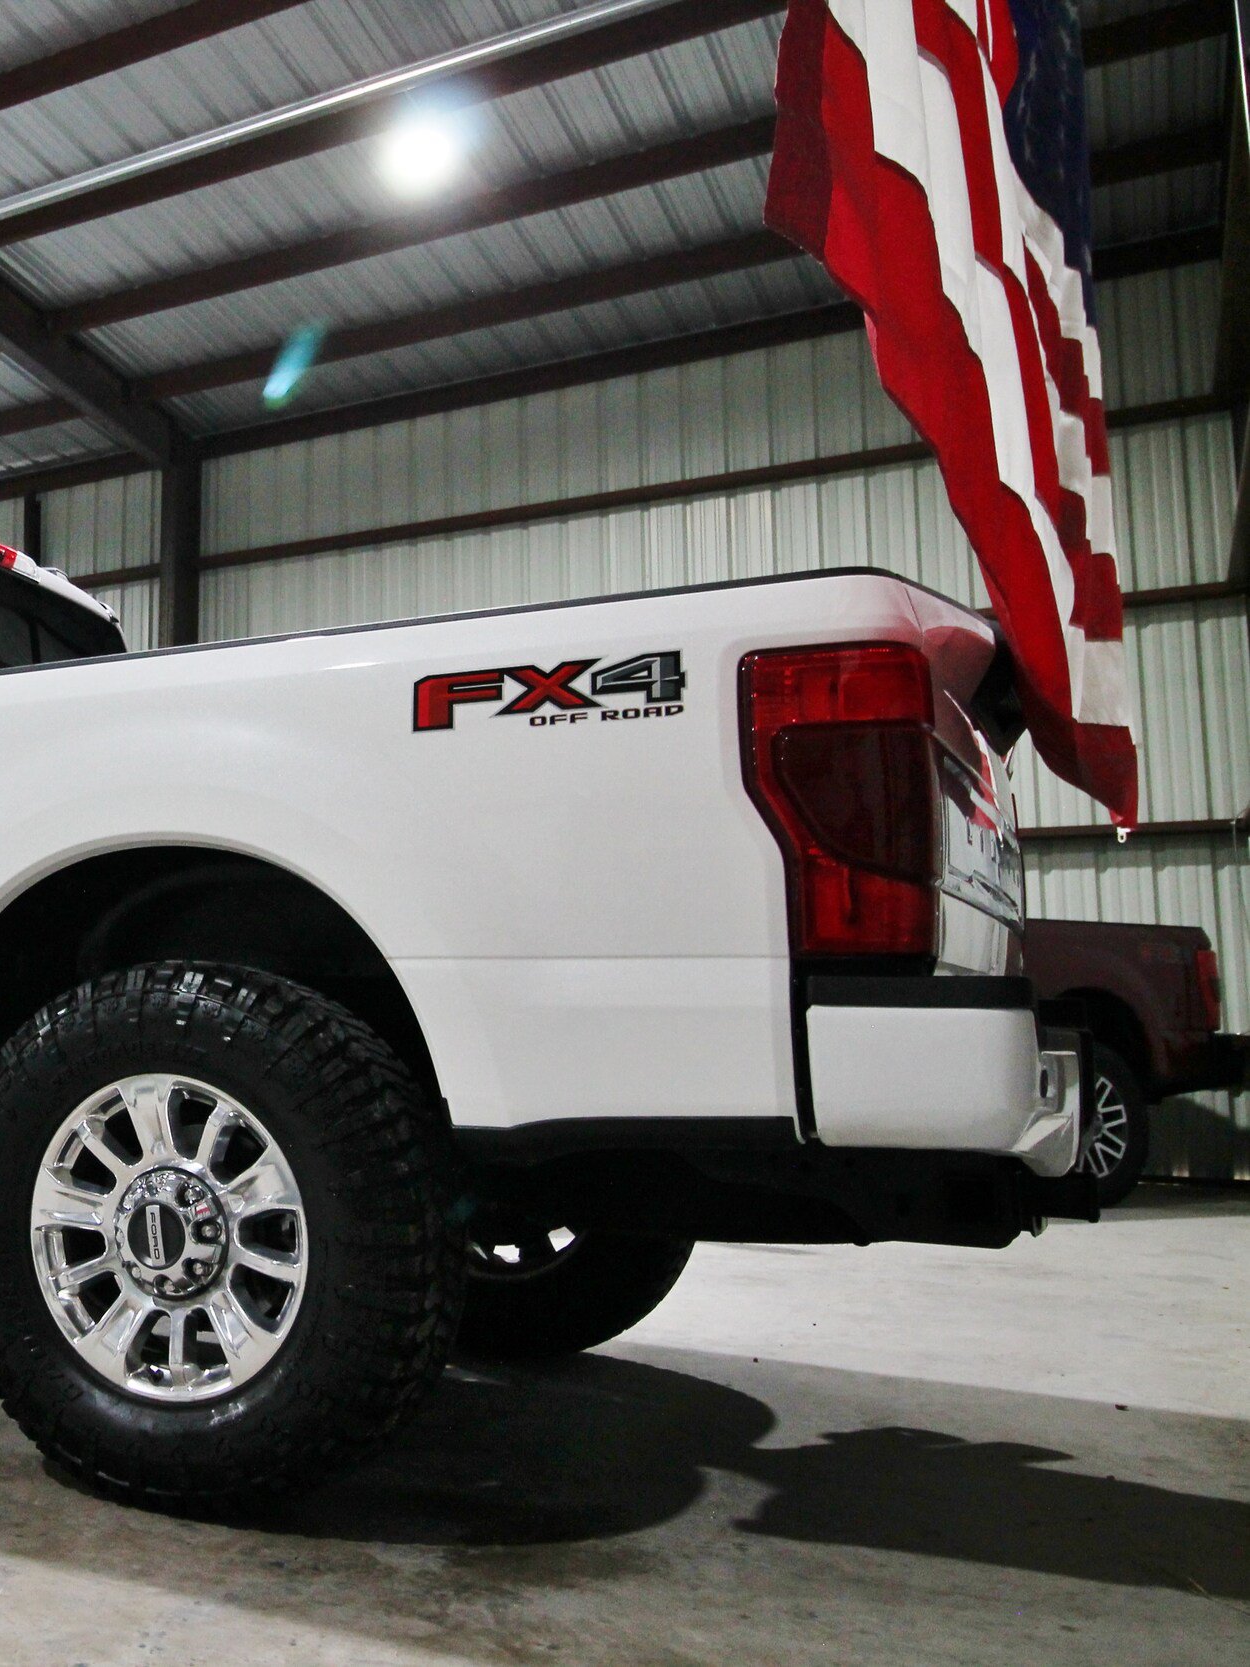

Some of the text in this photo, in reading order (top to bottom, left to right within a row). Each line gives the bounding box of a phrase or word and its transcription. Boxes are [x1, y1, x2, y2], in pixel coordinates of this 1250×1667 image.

[412, 650, 686, 732] FX4
[529, 705, 684, 727] OFF ROAD
[149, 1212, 160, 1260] FORD
